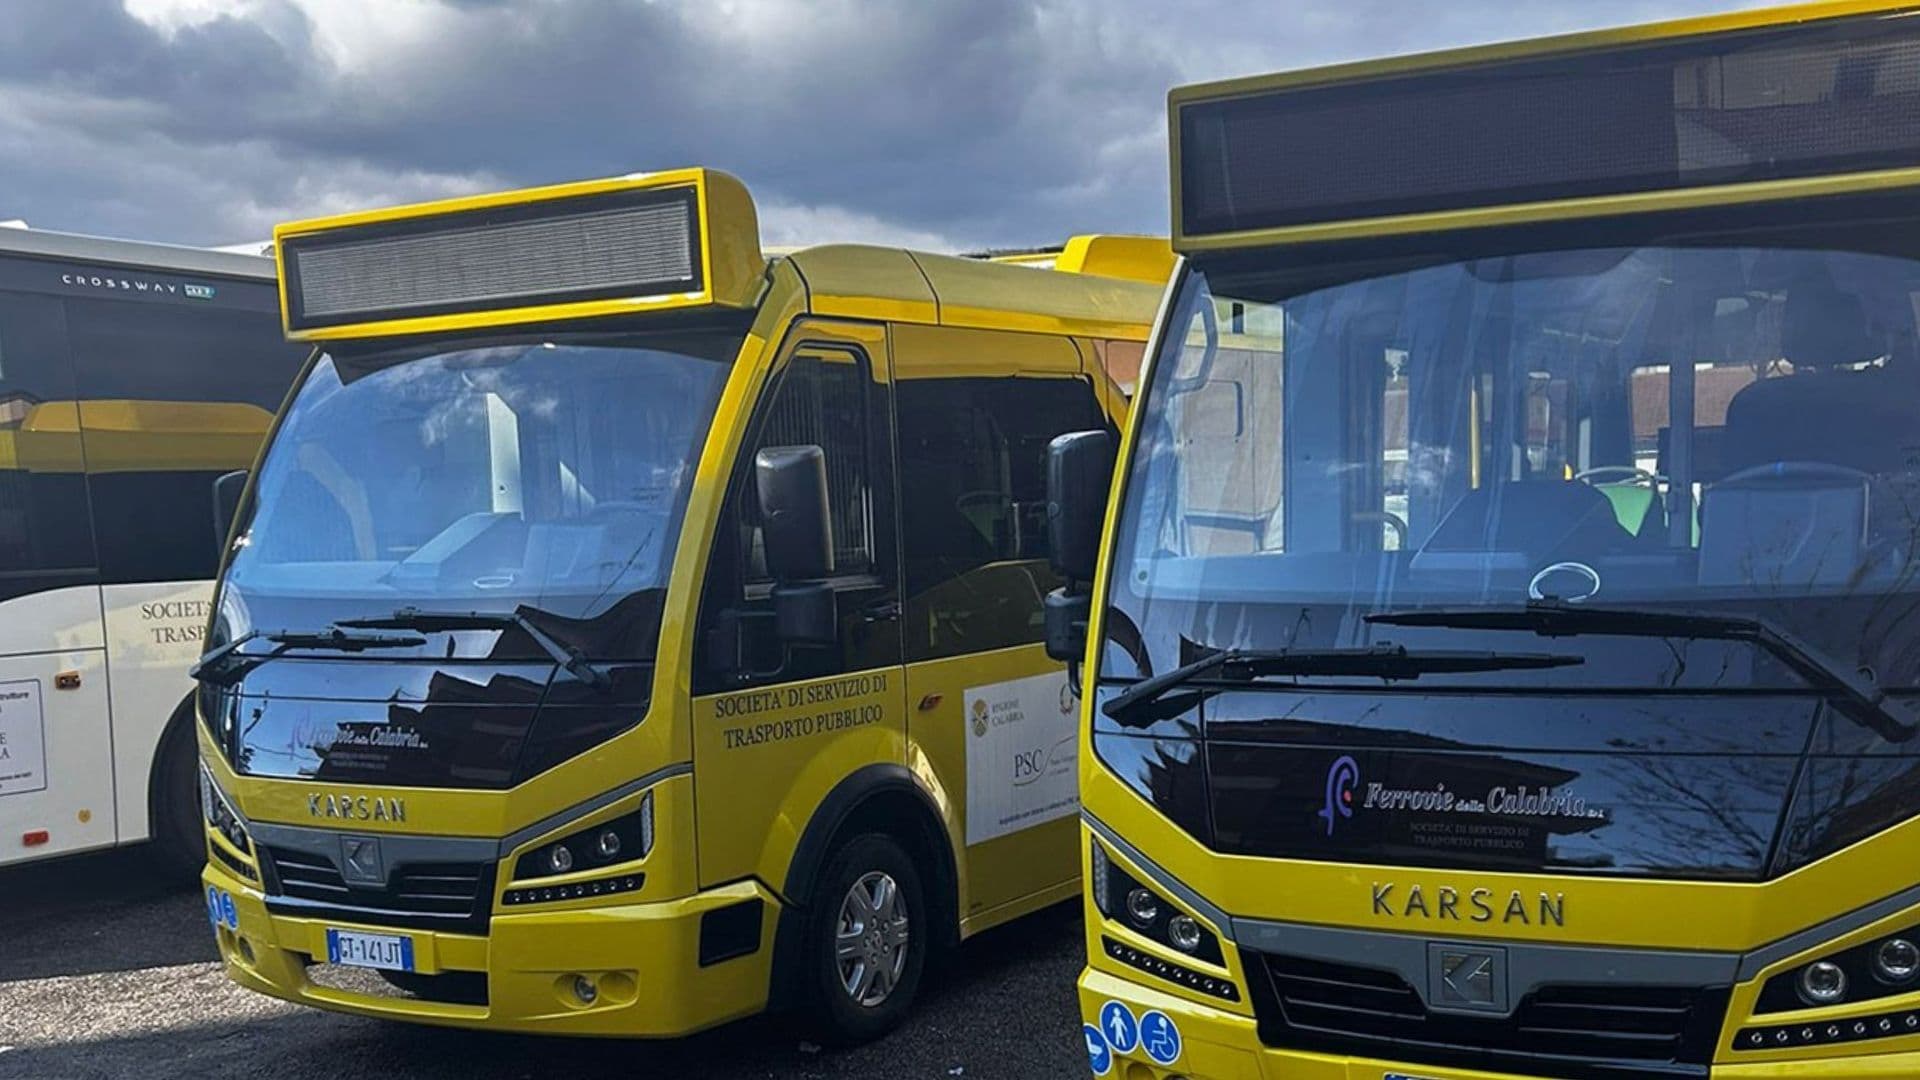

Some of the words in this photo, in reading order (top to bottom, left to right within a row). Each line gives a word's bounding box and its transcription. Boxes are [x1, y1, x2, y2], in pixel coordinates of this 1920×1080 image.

[62, 274, 176, 293] CROSSWAY
[151, 625, 208, 644] TRASP
[715, 690, 785, 719] SOCIETA'
[788, 690, 803, 708] DI
[807, 679, 869, 704] SERVIZIO
[873, 674, 887, 693] DI
[370, 726, 419, 748] Calabria
[724, 716, 813, 749] TRASPORTO
[816, 704, 882, 732] PUBBLICO
[1014, 749, 1042, 778] PSC
[308, 792, 406, 822] KARSAN
[1363, 782, 1454, 812] Ferrovie
[1455, 799, 1485, 813] della
[1486, 786, 1586, 817] Calabria
[1371, 881, 1565, 927] KARSAN
